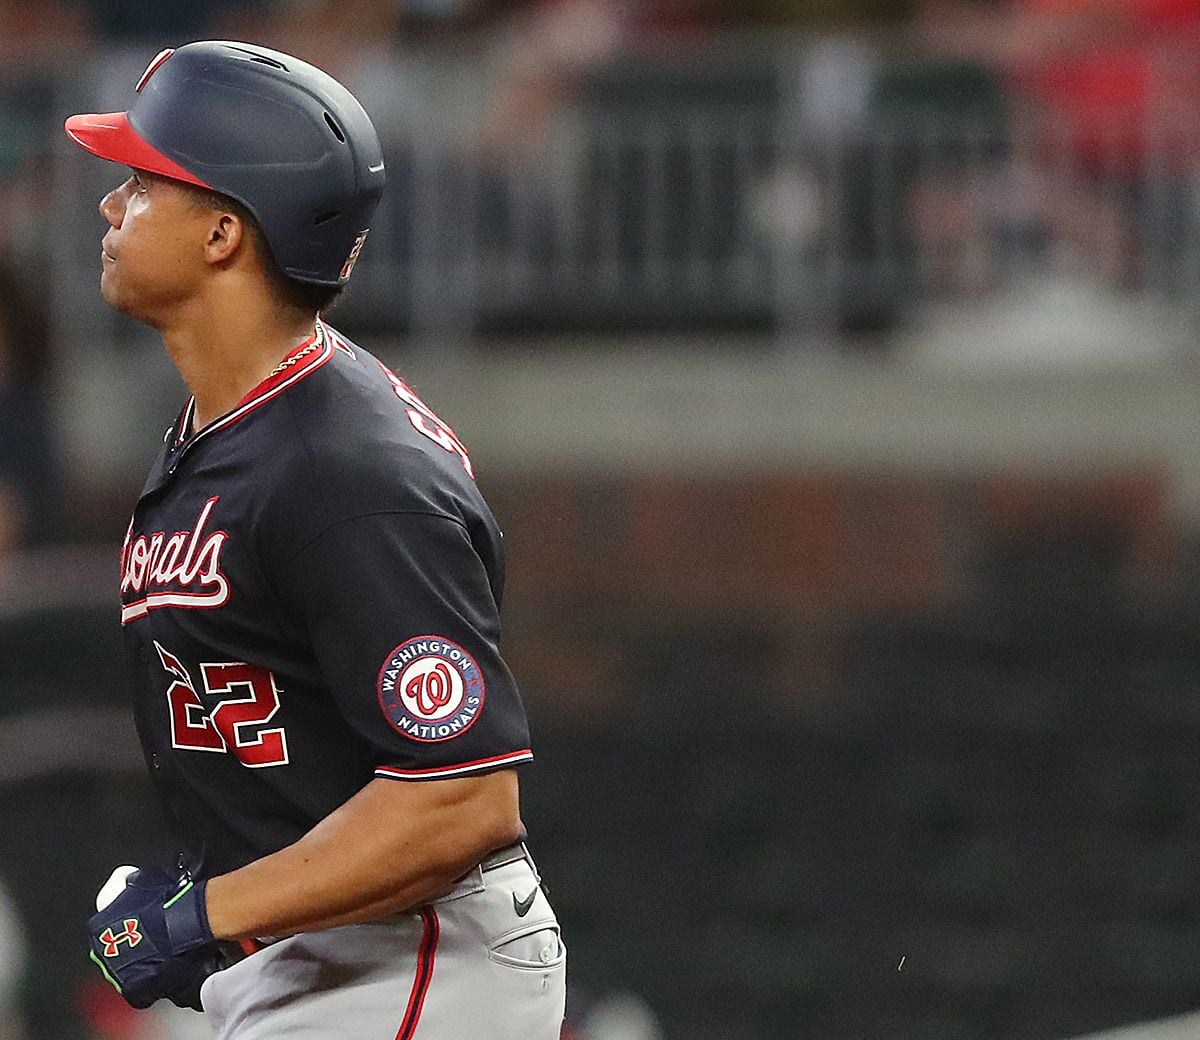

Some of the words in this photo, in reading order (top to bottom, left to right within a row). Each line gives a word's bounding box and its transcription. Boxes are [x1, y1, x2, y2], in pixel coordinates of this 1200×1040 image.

[383, 641, 472, 692] WASHINGTON
[153, 640, 290, 769] 22
[397, 696, 480, 738] NATIONALS
